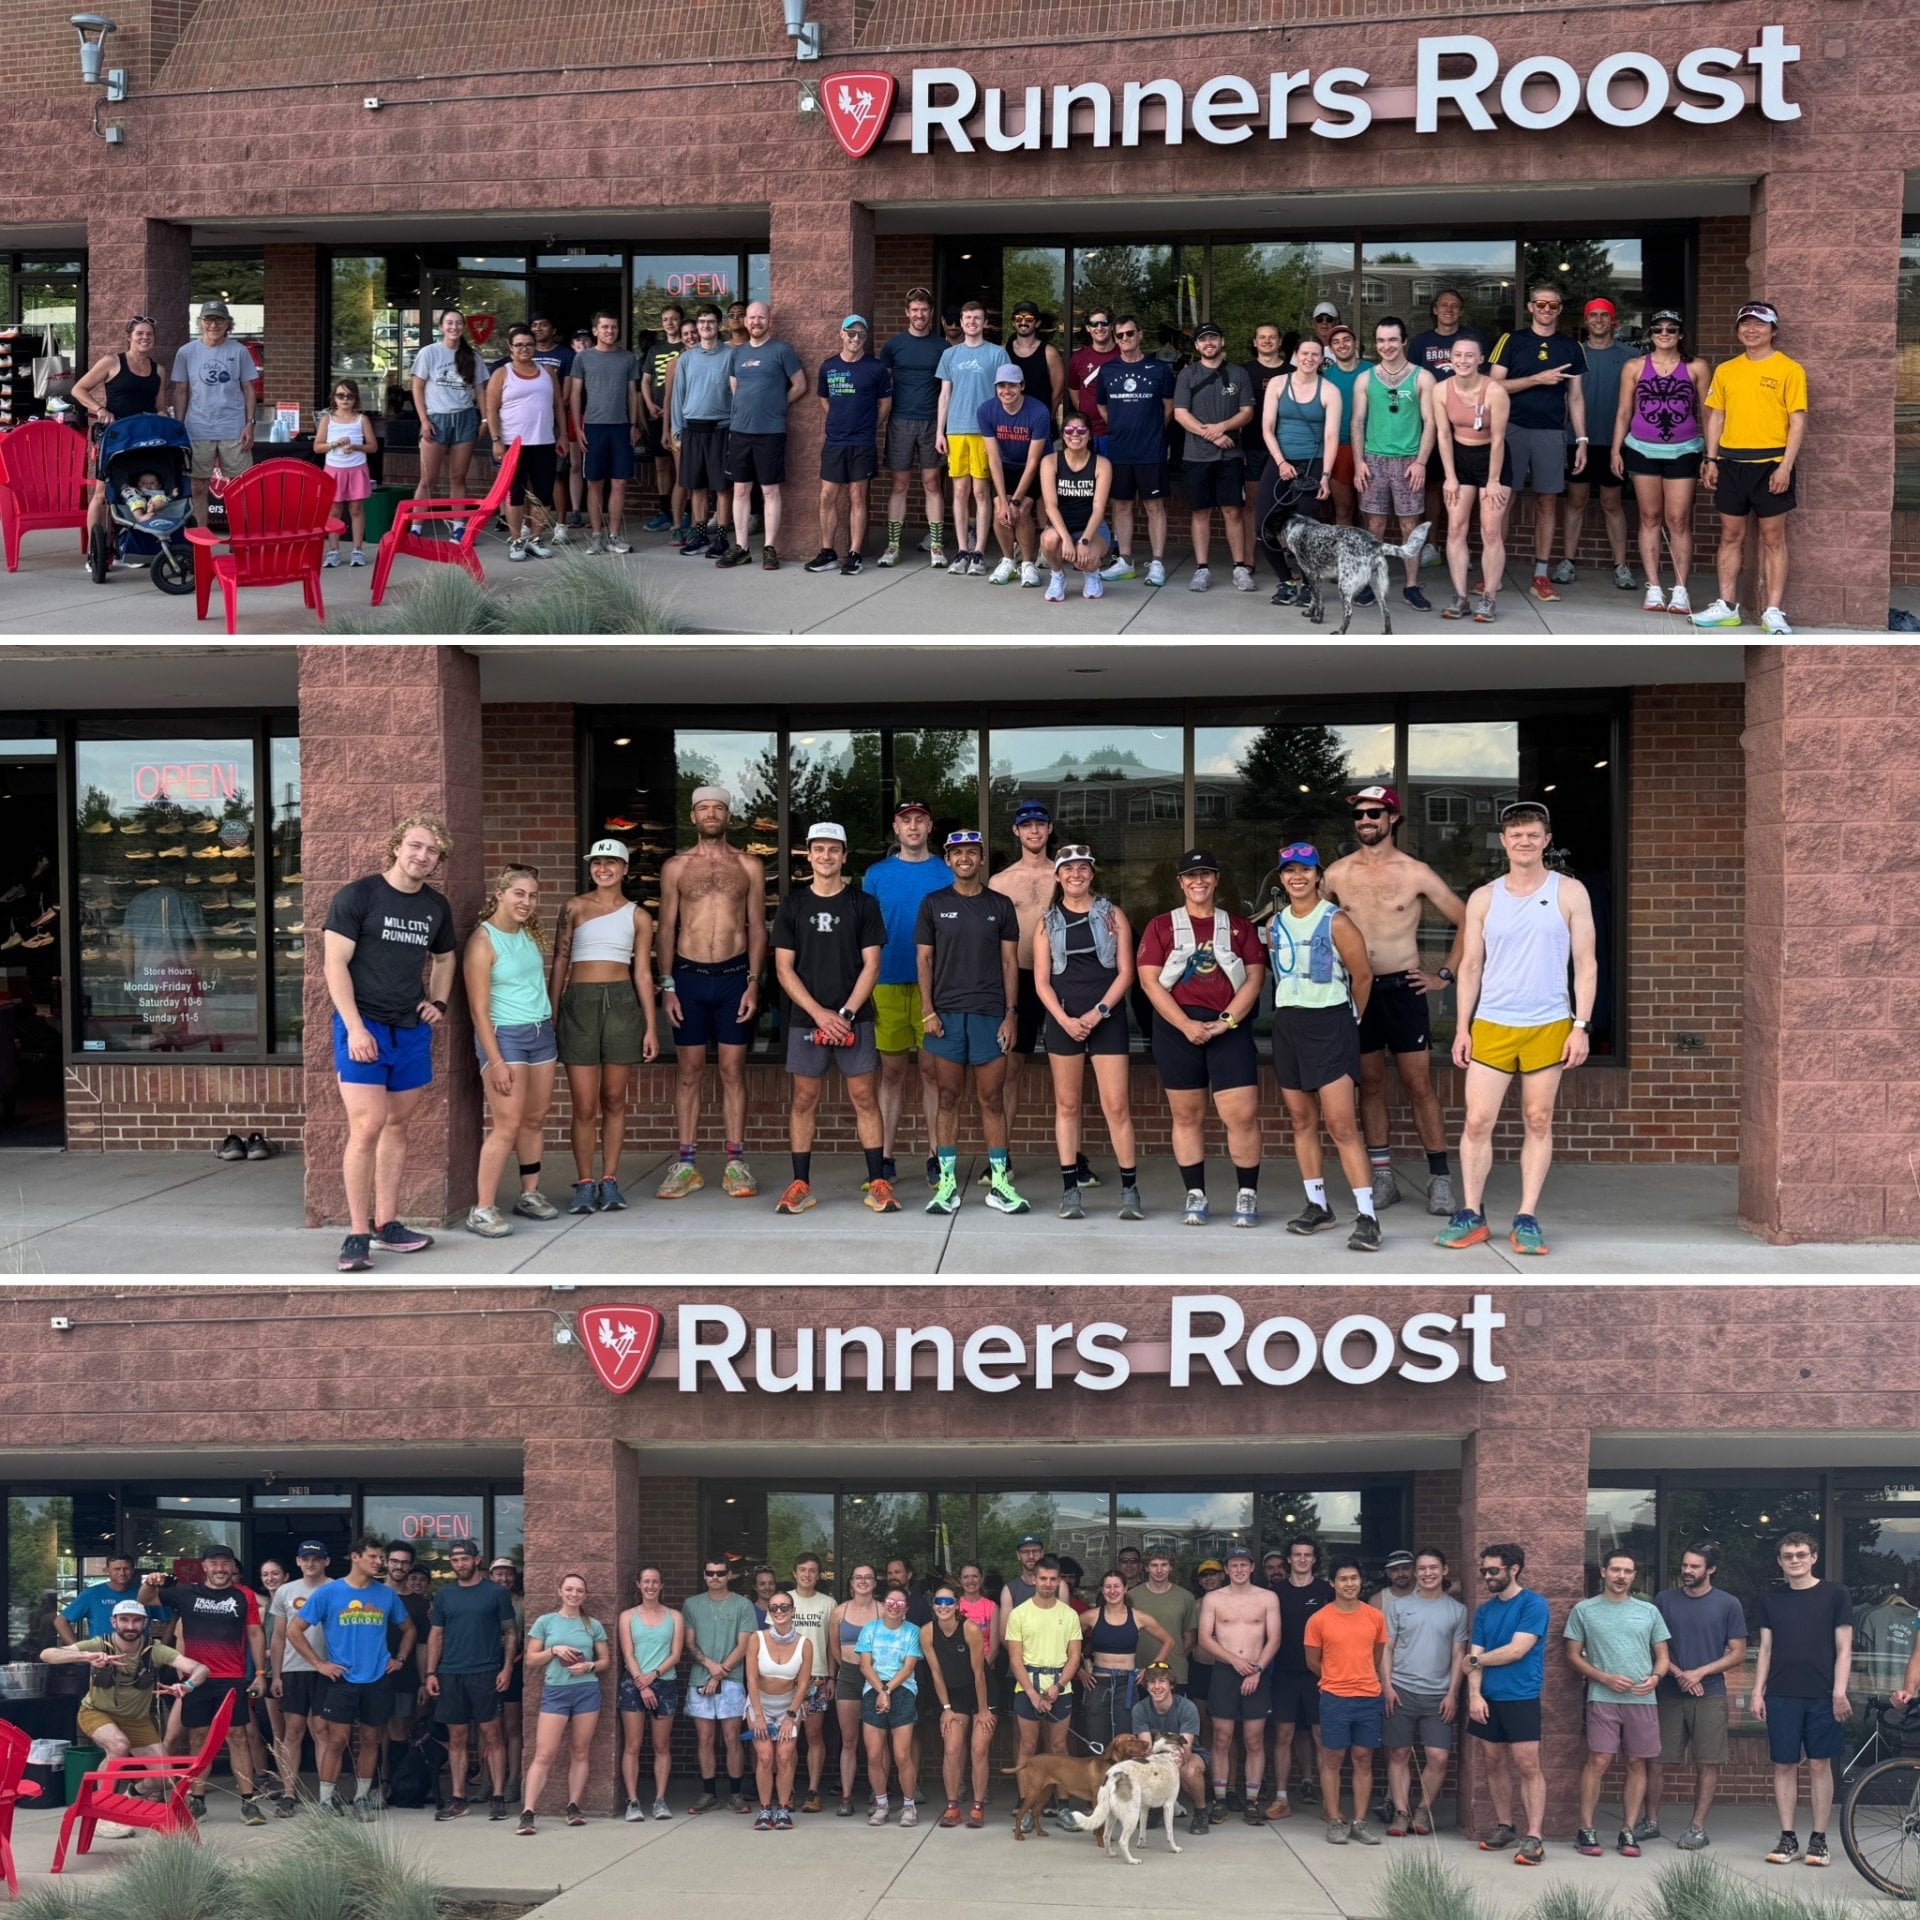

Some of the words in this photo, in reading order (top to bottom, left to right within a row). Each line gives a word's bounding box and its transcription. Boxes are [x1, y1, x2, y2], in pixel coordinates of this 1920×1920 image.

[911, 67, 1373, 154] Runners
[1415, 25, 1801, 133] Roost
[667, 273, 726, 295] OPEN
[1426, 350, 1451, 360] BRON
[996, 424, 1012, 433] MILL
[1013, 426, 1029, 434] CITY
[996, 432, 1030, 441] RUNNING
[1058, 479, 1076, 489] MILL
[1077, 480, 1094, 489] CITY
[1057, 488, 1094, 497] RUNNING
[208, 504, 224, 514] ers
[136, 763, 236, 800] OPEN
[384, 916, 407, 930] MILL
[408, 919, 429, 933] CITY
[381, 929, 429, 946] RUNNING
[143, 966, 166, 976] Store
[168, 967, 196, 976] Hours:
[123, 981, 192, 993] Monday-Friday
[197, 981, 217, 991] 10-7
[138, 997, 180, 1008] Saturday
[183, 997, 202, 1007] 10-6
[143, 1012, 177, 1024] Sunday
[180, 1013, 199, 1022] 11-5
[678, 1304, 1131, 1393] Runners
[1170, 1294, 1507, 1387] Roost
[402, 1514, 469, 1538] OPEN
[794, 1620, 821, 1628] UNNING
